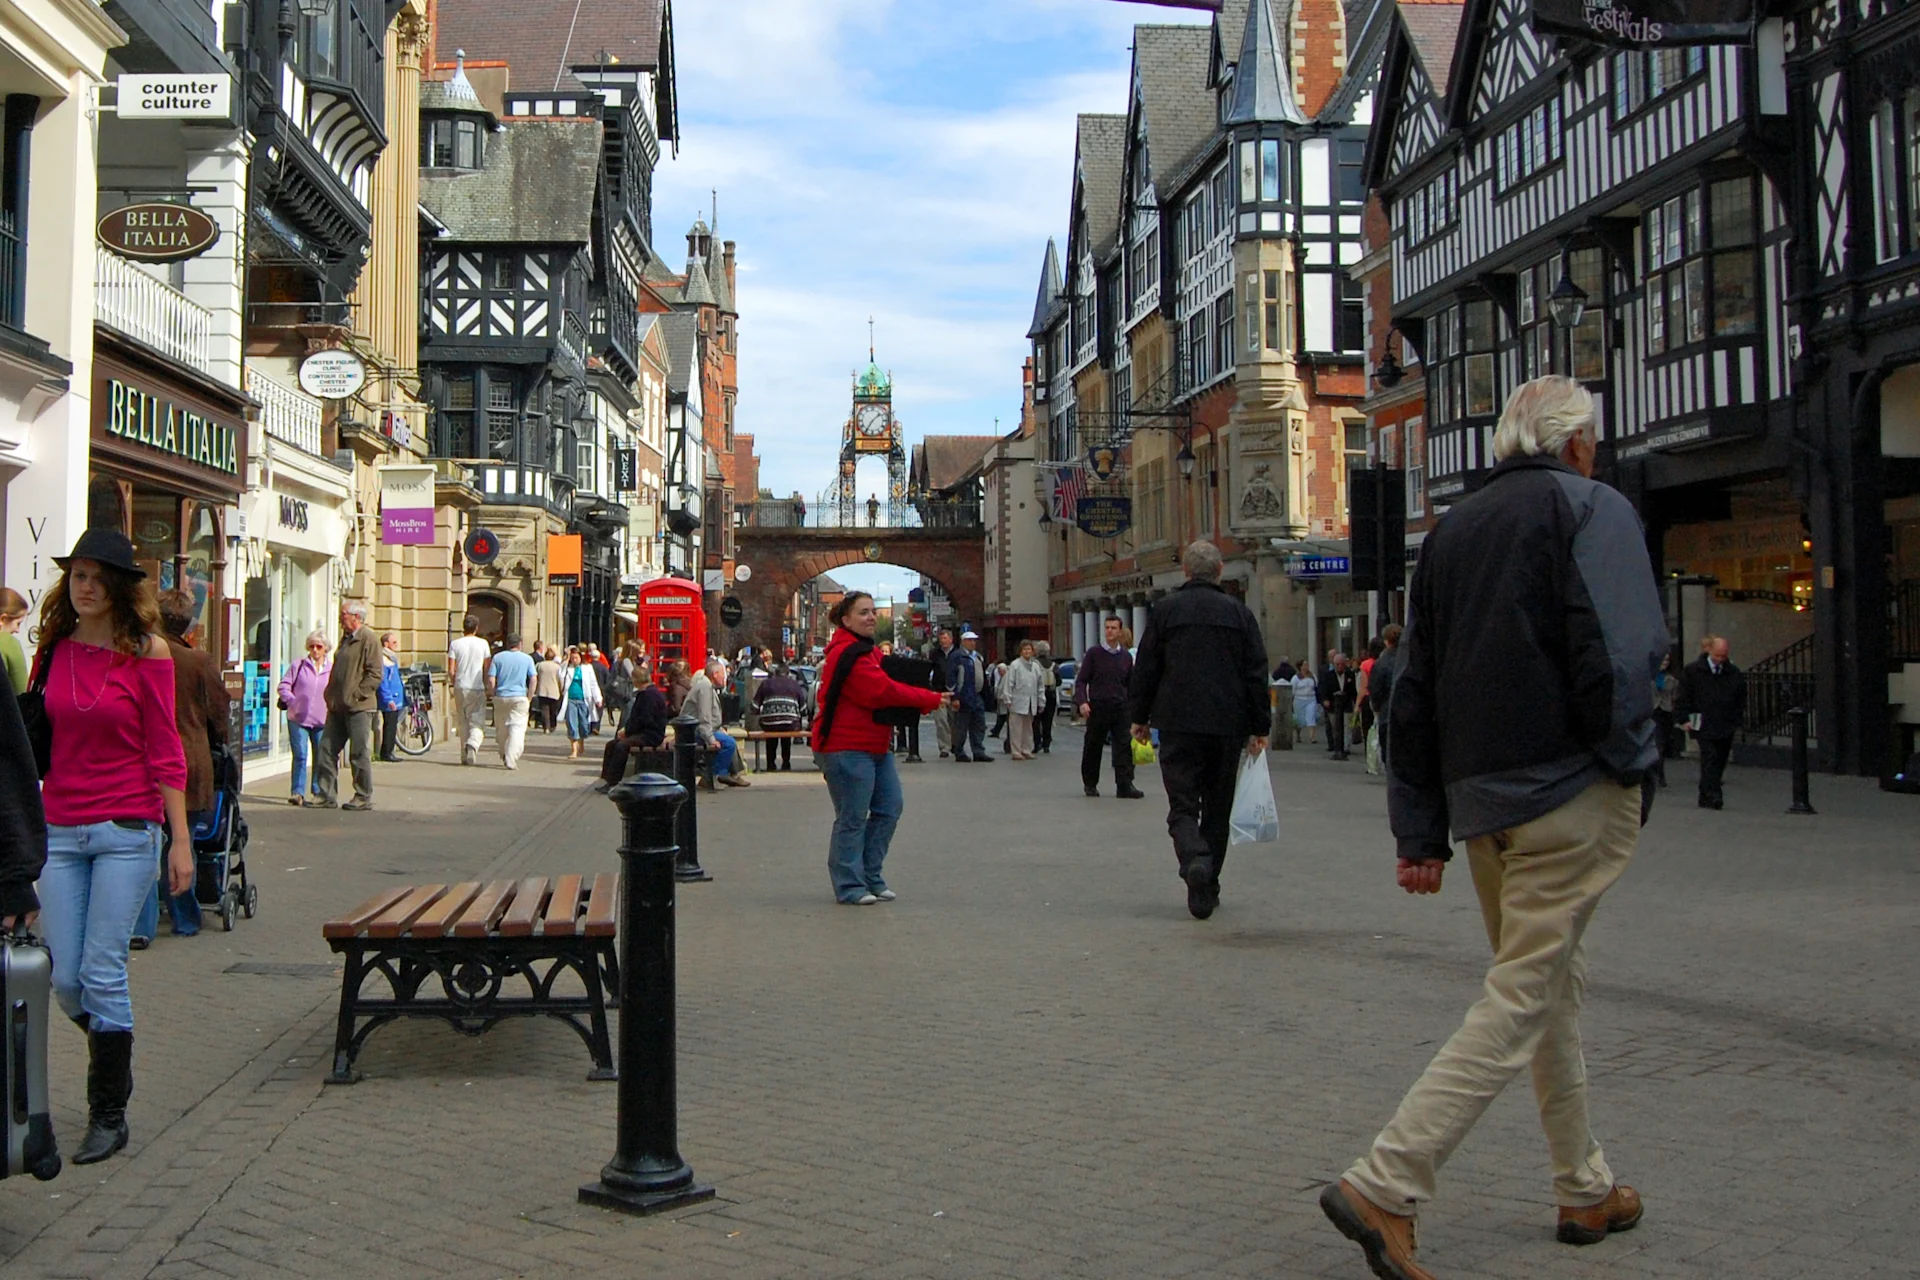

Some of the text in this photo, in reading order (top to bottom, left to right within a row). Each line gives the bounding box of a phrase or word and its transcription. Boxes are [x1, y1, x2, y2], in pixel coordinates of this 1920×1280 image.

[1582, 4, 1663, 42] Festivals
[142, 81, 218, 95] counter
[142, 96, 212, 110] culture
[126, 211, 189, 227] BELLA
[124, 231, 191, 247] ITALIA
[107, 378, 239, 475] BELLA ITALIA
[620, 452, 631, 488] NEXT
[389, 482, 427, 493] MOSS
[278, 495, 308, 533] MOSS
[389, 518, 427, 528] MossBros
[1309, 559, 1345, 570] CENTRE
